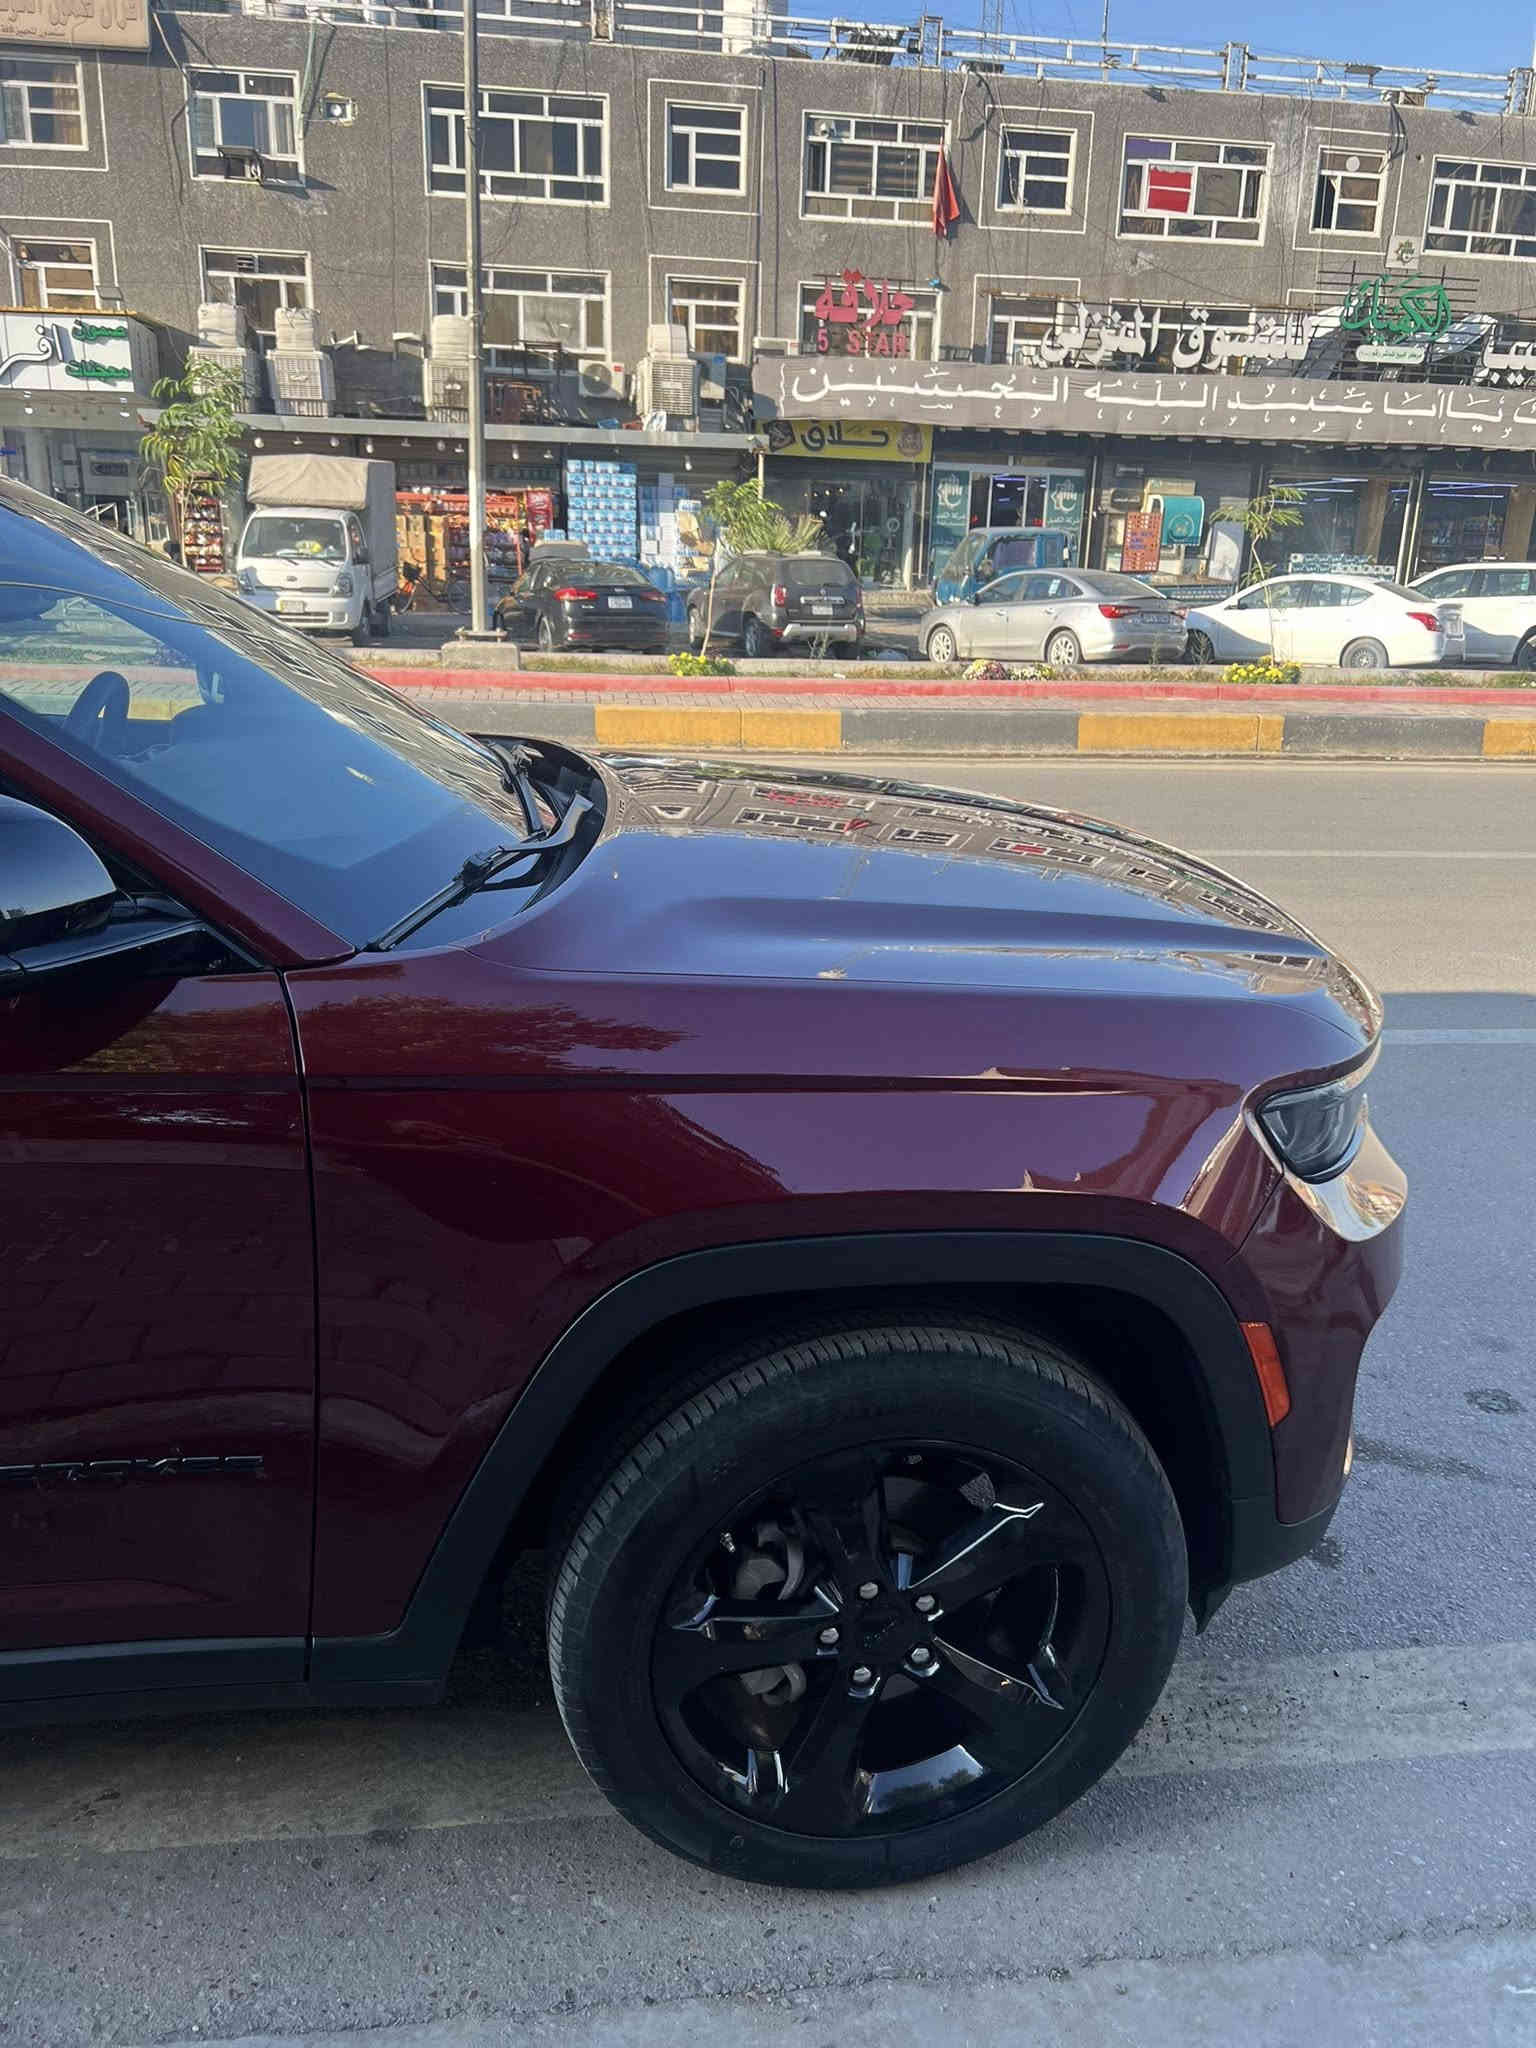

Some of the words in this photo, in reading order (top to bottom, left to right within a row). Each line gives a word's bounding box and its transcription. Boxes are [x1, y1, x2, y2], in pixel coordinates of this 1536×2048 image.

[817, 328, 829, 352] 5
[847, 330, 908, 358] STAR
[1034, 301, 1161, 368] المنزلي
[1171, 307, 1312, 370] للتسوق
[65, 360, 130, 380] معجنات
[792, 366, 1069, 416] الحسين
[801, 420, 889, 451] حلاق
